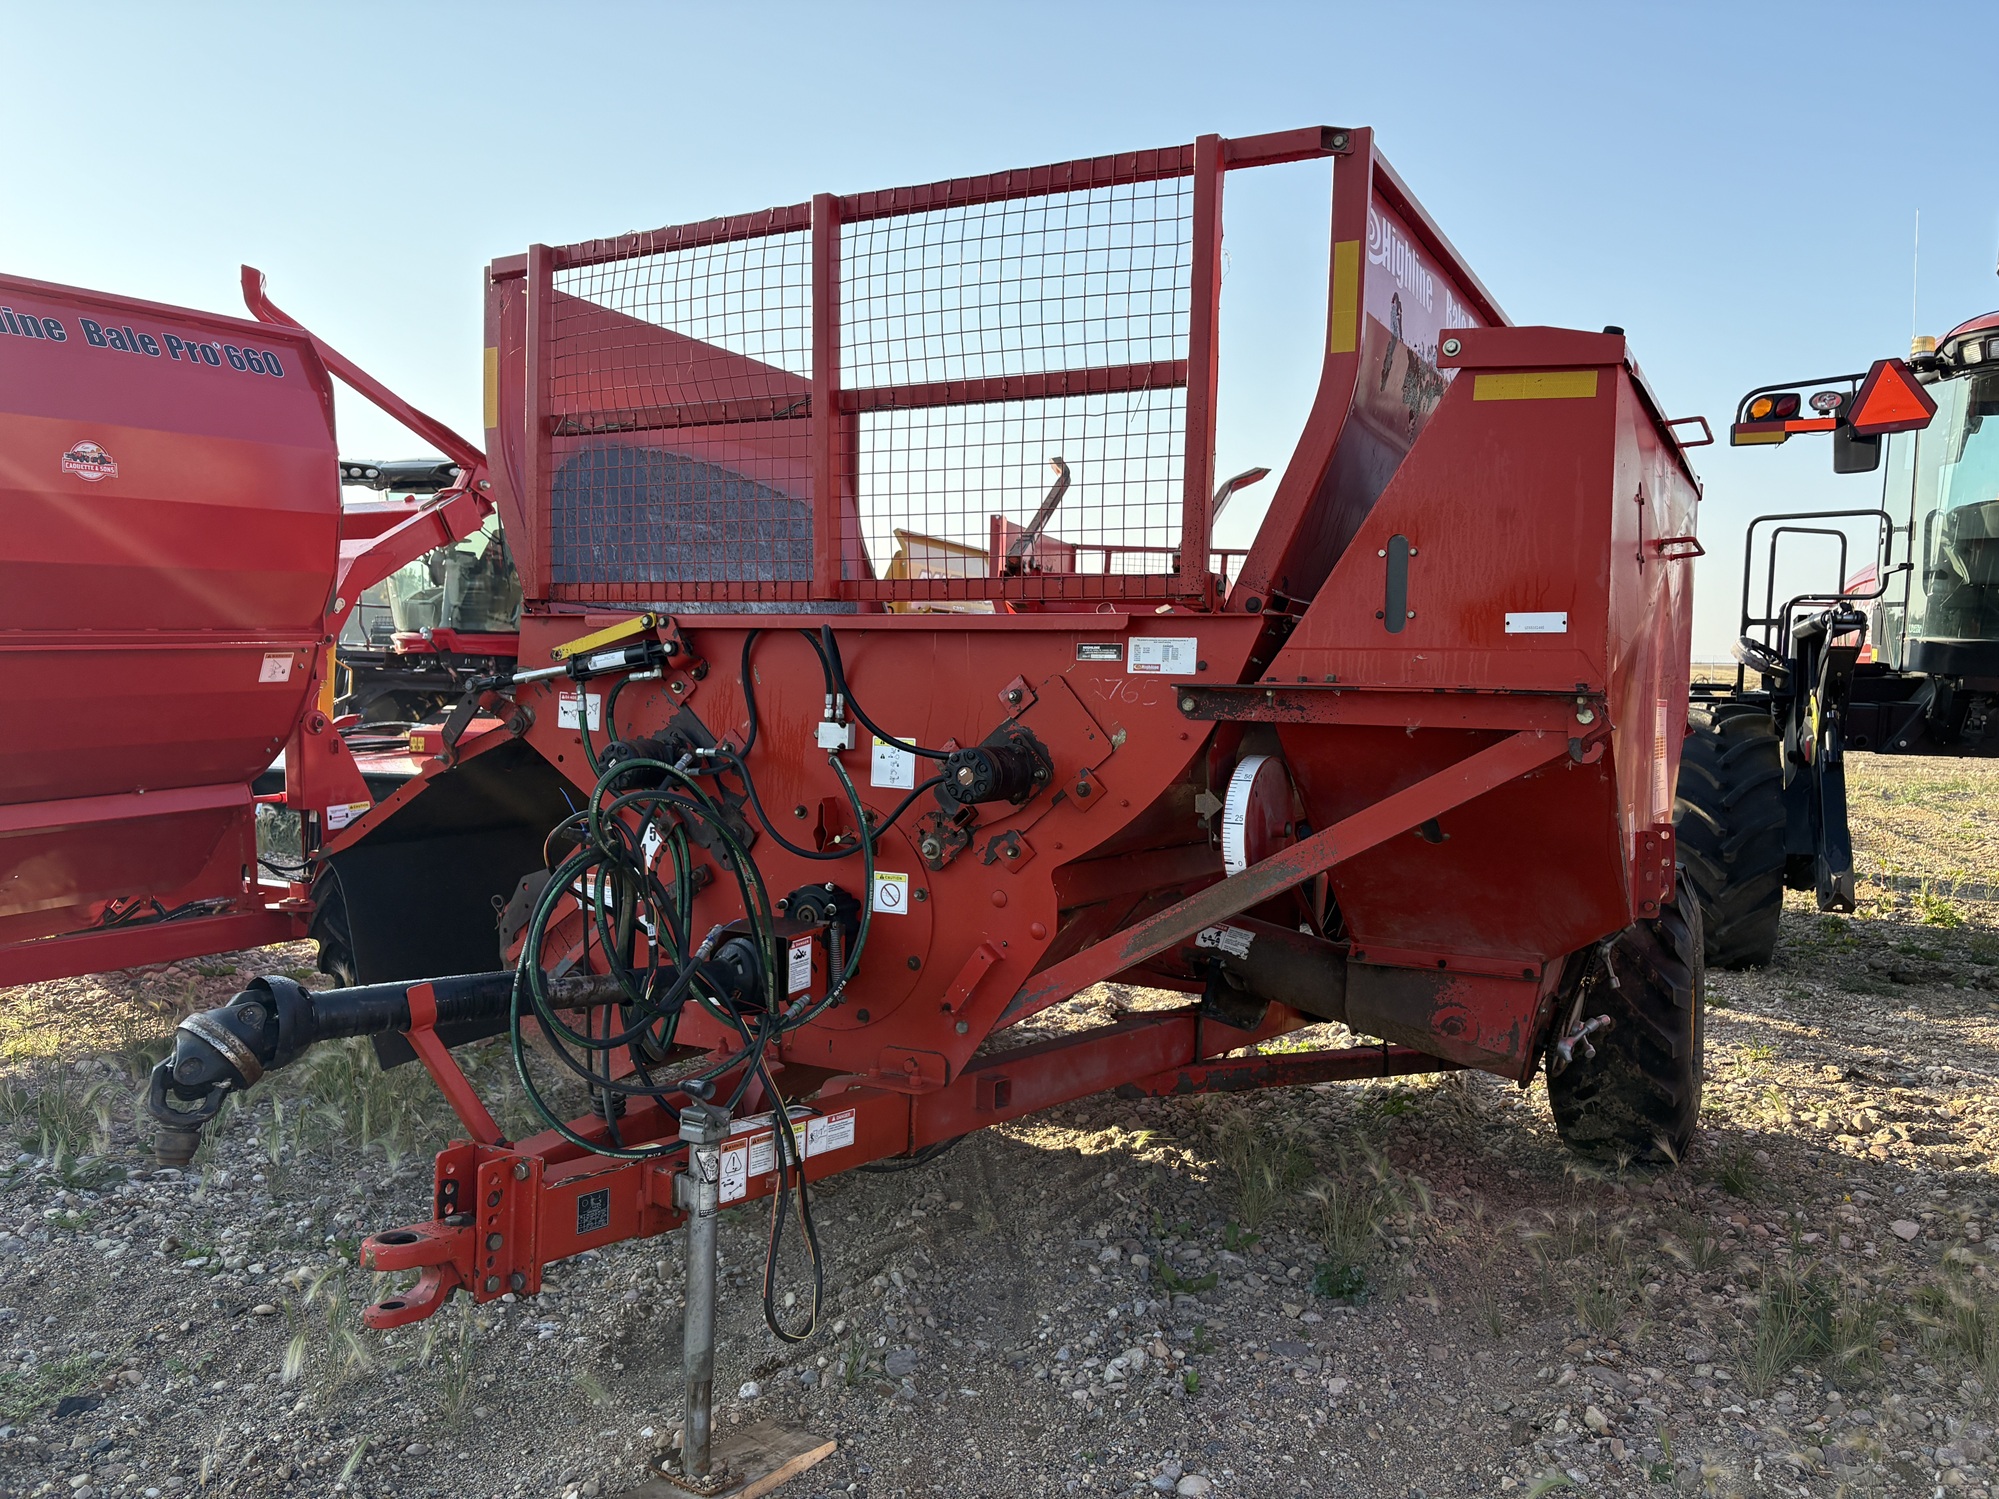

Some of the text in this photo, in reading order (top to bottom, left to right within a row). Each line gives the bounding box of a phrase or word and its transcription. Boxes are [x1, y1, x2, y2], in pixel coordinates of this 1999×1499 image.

[1382, 217, 1433, 314] Highline
[78, 317, 162, 357] Bale
[223, 344, 285, 378] 660
[1234, 814, 1244, 822] 25
[649, 826, 657, 842] 5
[836, 1112, 851, 1121] DANGER
